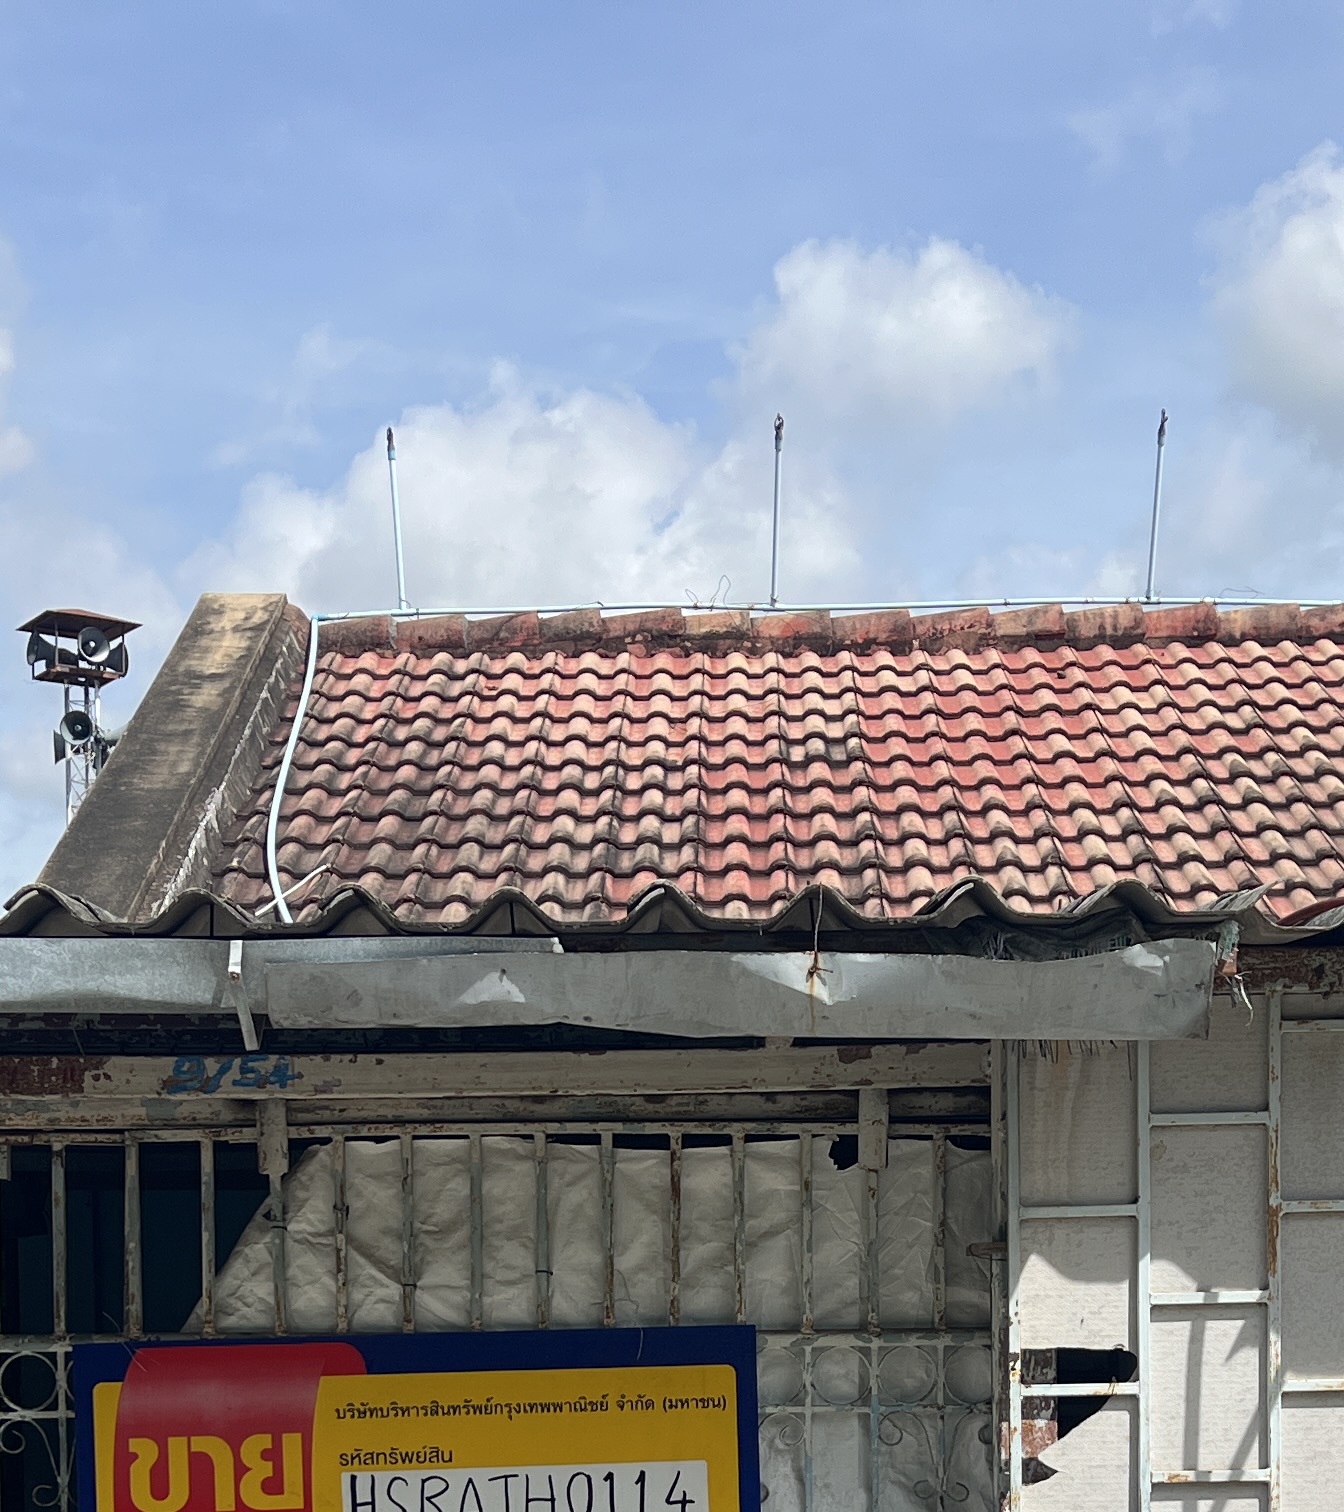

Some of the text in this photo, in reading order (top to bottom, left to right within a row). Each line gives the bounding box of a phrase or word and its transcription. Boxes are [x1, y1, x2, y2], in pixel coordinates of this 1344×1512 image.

[616, 1396, 655, 1412] จำกัด
[662, 1394, 727, 1413] (มหาชน)
[339, 1445, 453, 1467] รหัสทรัพย์สิน
